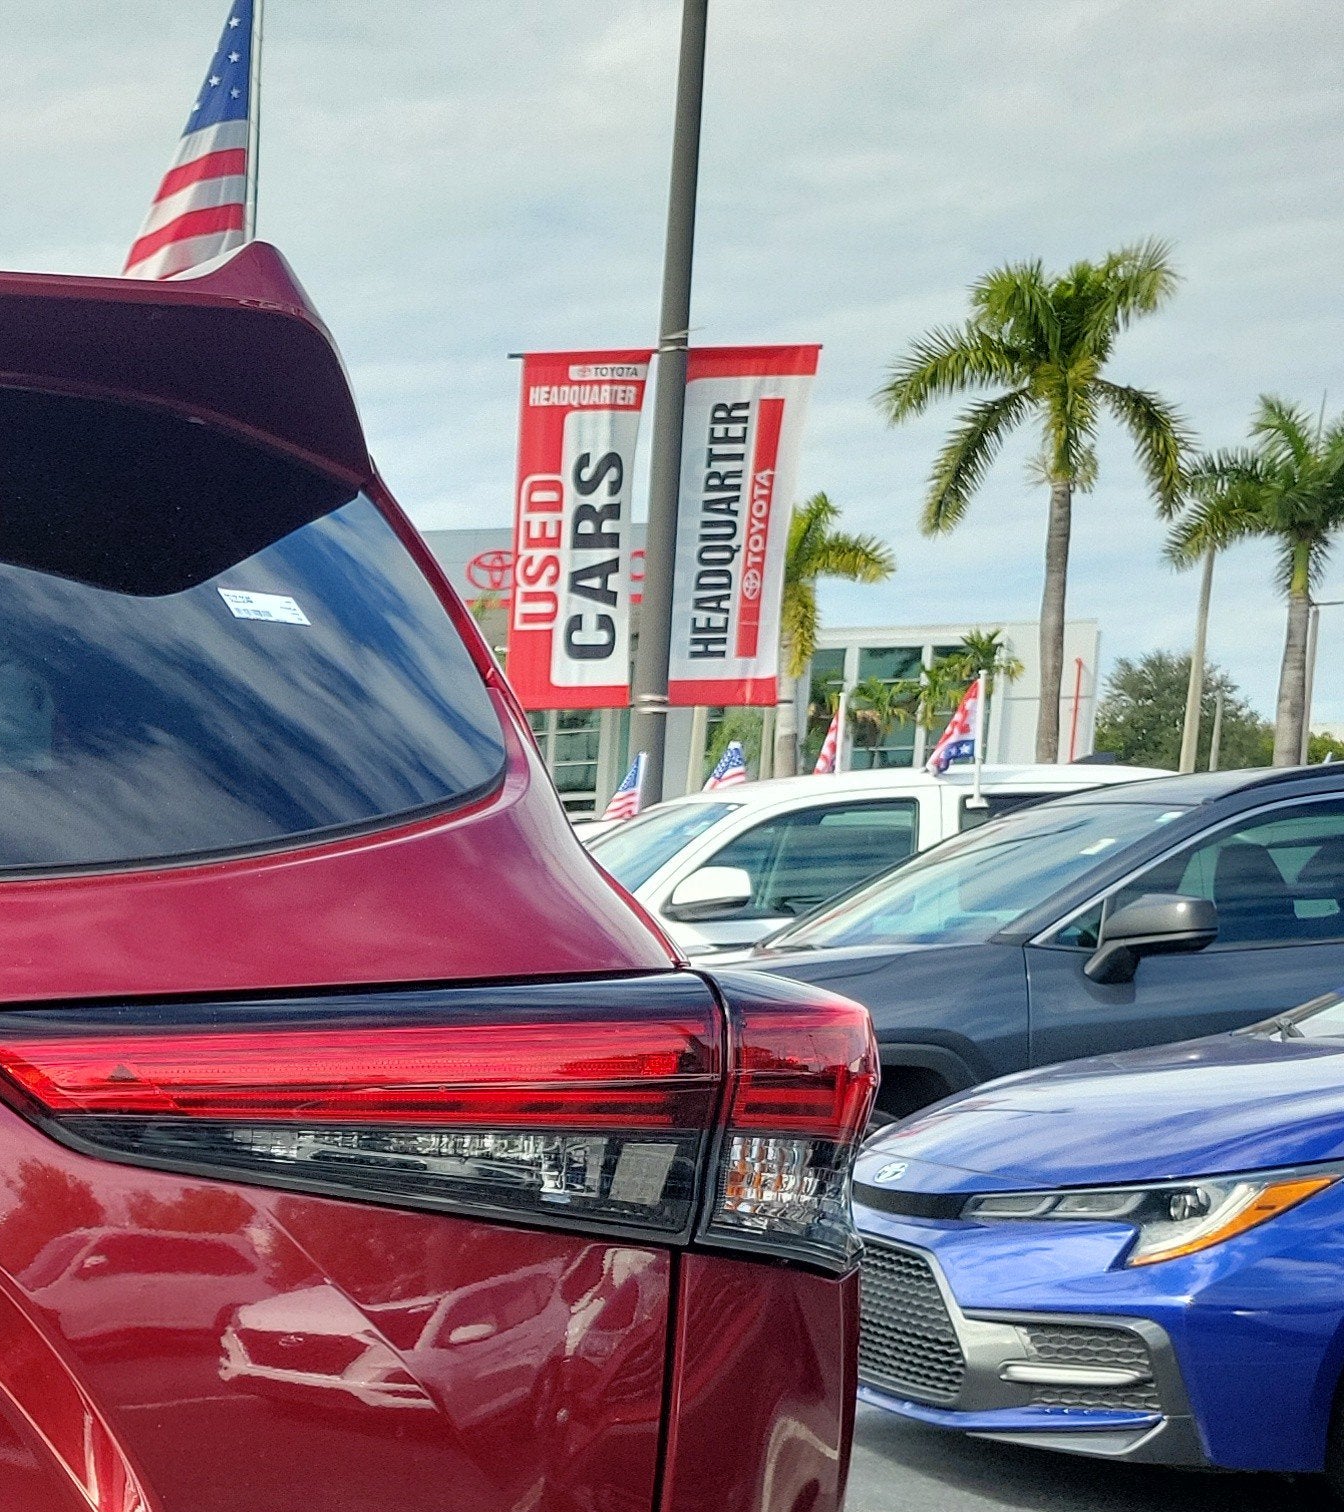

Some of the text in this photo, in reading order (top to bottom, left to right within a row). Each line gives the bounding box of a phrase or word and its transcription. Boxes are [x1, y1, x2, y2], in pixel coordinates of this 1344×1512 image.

[529, 385, 637, 407] HEADQUARTER
[594, 366, 638, 377] TOYOTA
[514, 474, 564, 631] USED
[565, 451, 624, 661] CARS
[688, 401, 751, 659] HEADQUARTER
[746, 468, 775, 564] TOYOTA
